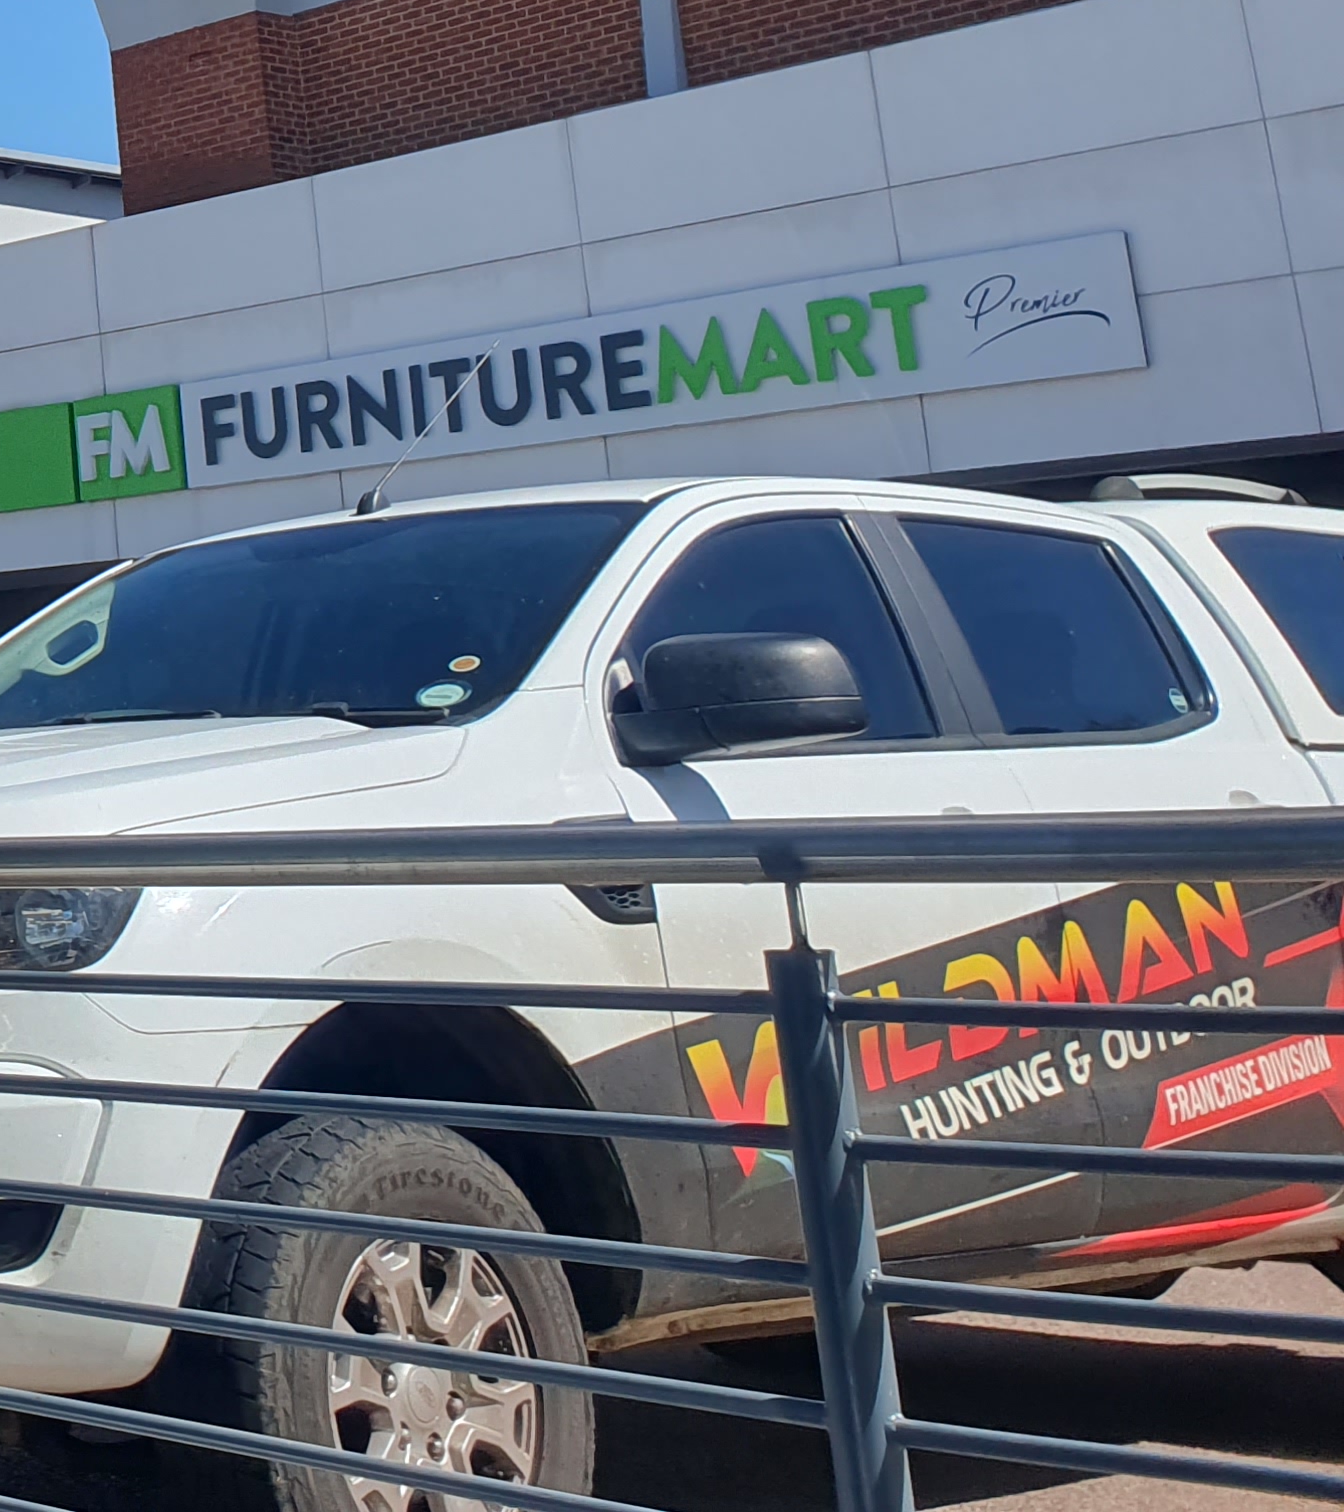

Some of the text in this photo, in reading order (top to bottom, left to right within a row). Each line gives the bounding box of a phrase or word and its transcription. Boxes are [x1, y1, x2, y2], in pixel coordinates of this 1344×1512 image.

[77, 404, 171, 482] FM
[964, 274, 1086, 332] Premier
[899, 1051, 1065, 1140] HUNTING
[1062, 1040, 1092, 1086] &
[1164, 1034, 1333, 1126] FRANCHISE DIVISION
[373, 1167, 506, 1224] Firestone
